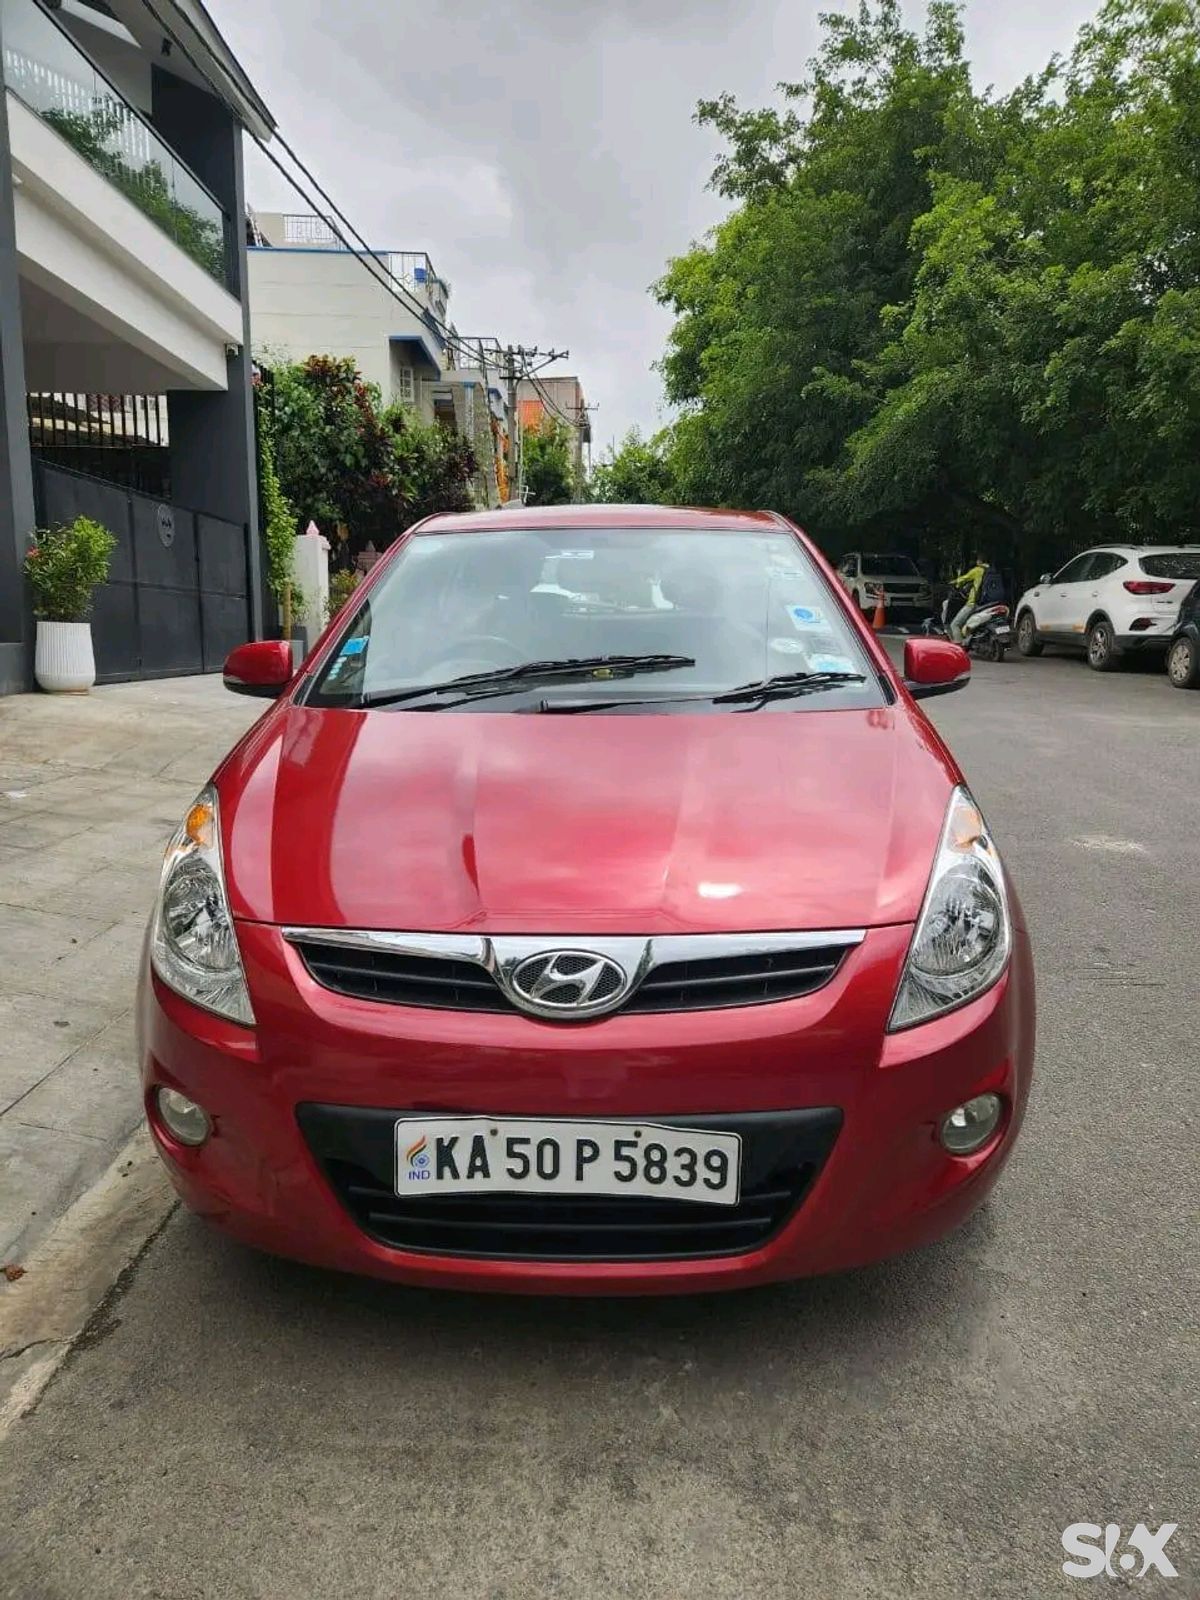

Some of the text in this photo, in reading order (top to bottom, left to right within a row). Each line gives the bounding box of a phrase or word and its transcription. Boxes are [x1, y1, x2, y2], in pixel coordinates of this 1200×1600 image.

[408, 1170, 430, 1180] IND
[436, 1135, 729, 1190] KA 50 P 5839
